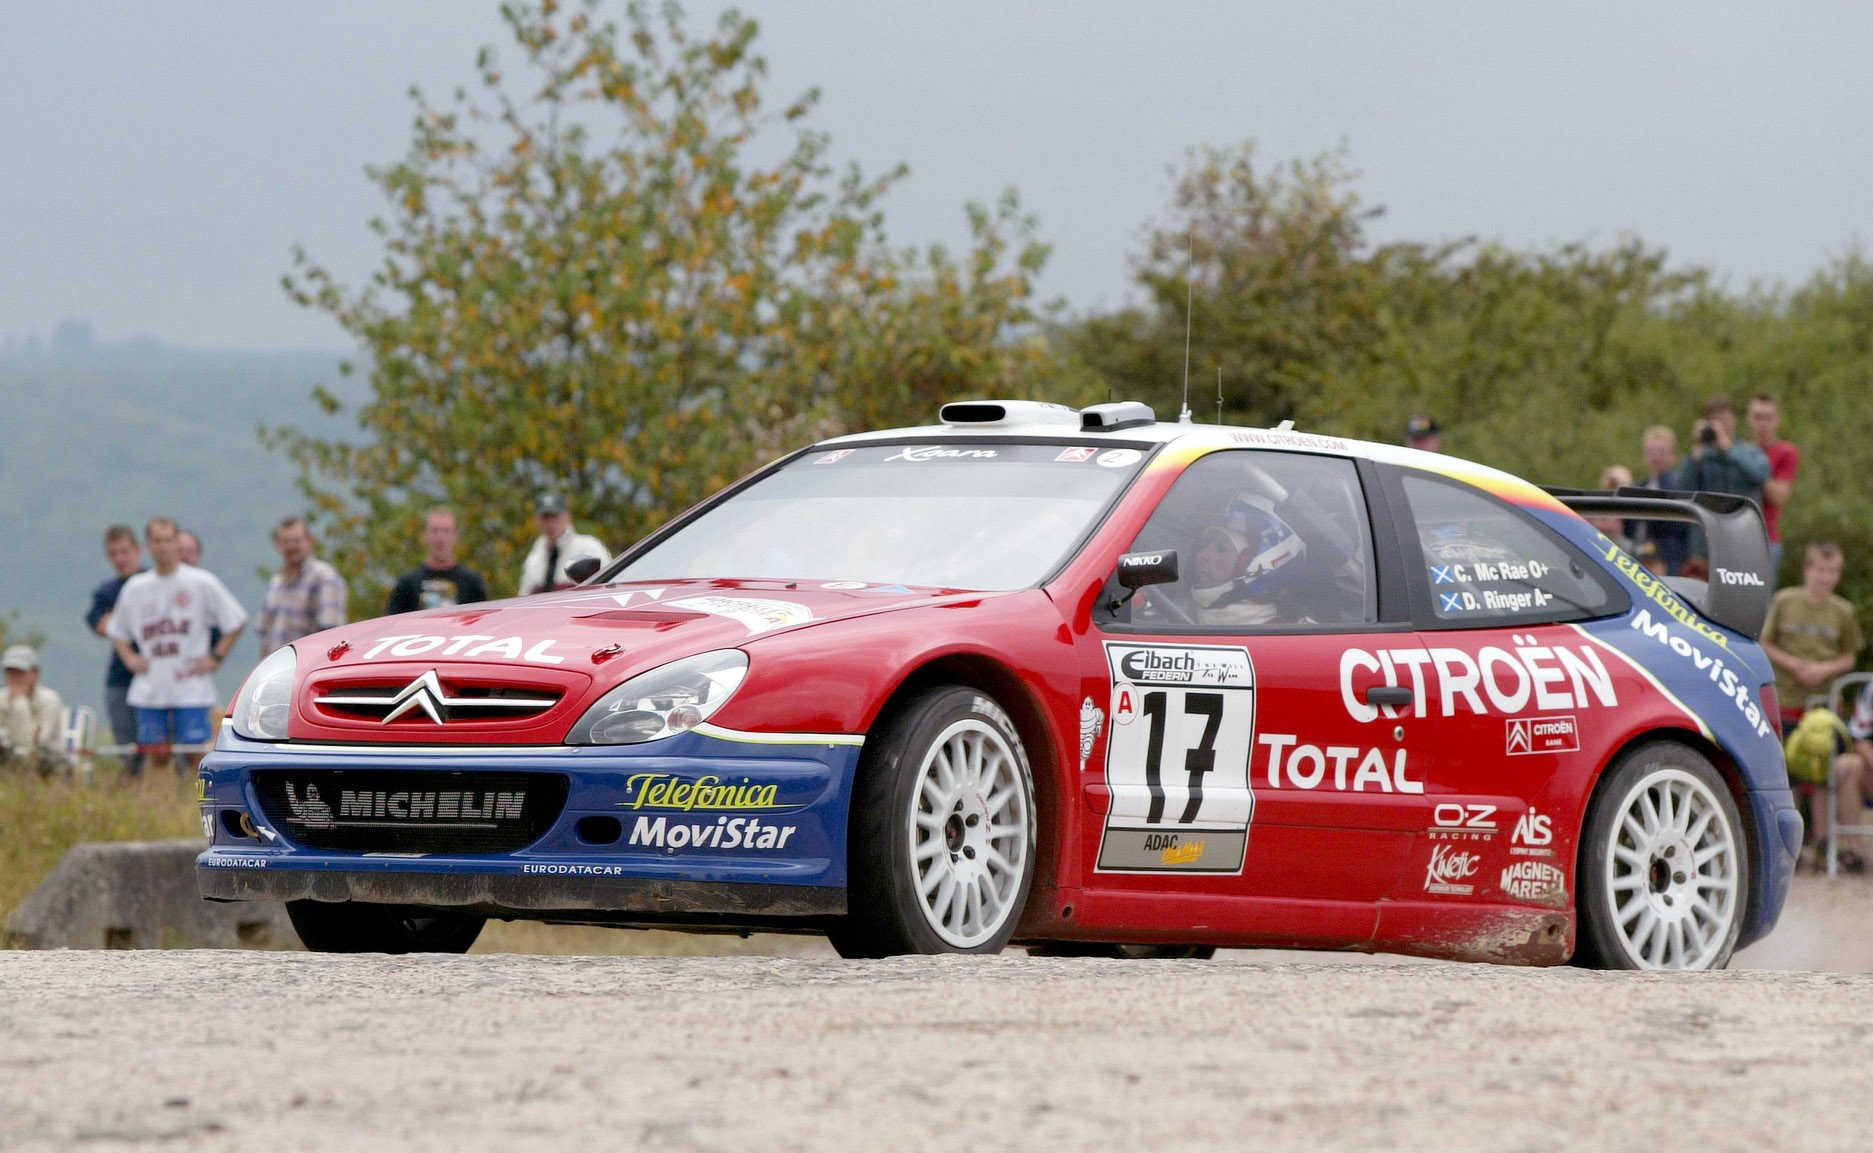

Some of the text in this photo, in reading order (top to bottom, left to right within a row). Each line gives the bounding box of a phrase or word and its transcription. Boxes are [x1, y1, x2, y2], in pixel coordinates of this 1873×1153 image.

[1123, 555, 1163, 567] NIKKO
[1454, 564, 1472, 582] C.
[1717, 568, 1764, 586] TOTAL
[1462, 592, 1481, 610] D.
[1483, 590, 1532, 611] Ringer
[363, 634, 565, 664] TOTAL
[1121, 650, 1195, 680] Eibach
[1631, 609, 1770, 737] MoviStar
[1141, 670, 1193, 681] FEDERN
[1340, 634, 1619, 723] CITROËN
[1118, 691, 1133, 713] A
[1533, 720, 1573, 735] CITROËN
[1545, 738, 1563, 747] BANK
[1143, 691, 1224, 824] 17
[1258, 733, 1425, 794] TOTAL
[340, 790, 525, 819] MICHELIN
[628, 816, 797, 849] MoviStar
[1143, 833, 1179, 851] ADAC
[1429, 832, 1492, 841] RACING
[208, 857, 267, 868] EURODATACAR
[523, 864, 622, 875] EURODATACAR
